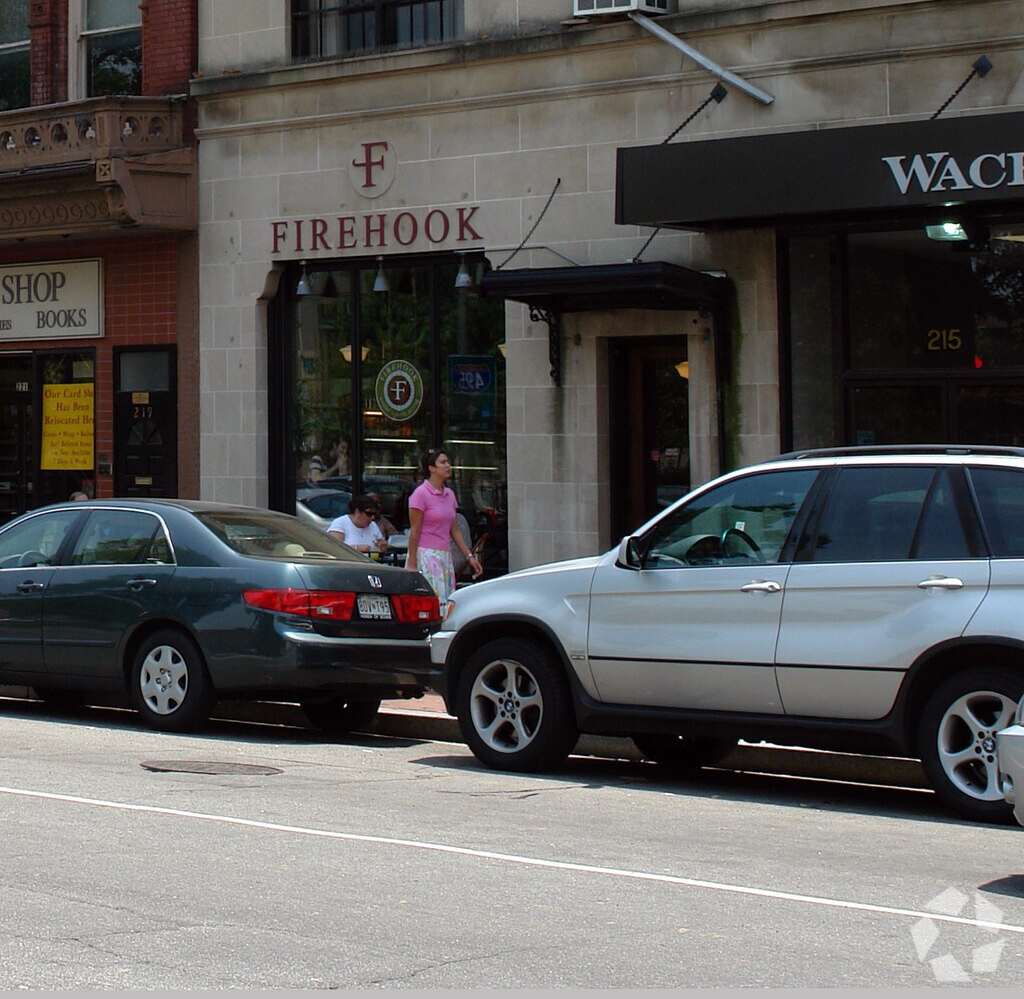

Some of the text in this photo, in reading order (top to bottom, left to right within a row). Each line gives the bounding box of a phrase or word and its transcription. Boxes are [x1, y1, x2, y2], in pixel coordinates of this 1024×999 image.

[270, 206, 484, 253] FIREHOOK
[2, 271, 66, 305] SHOP
[36, 308, 87, 329] BOOKS
[927, 329, 962, 350] 215
[44, 389, 60, 399] Our
[63, 388, 81, 398] Card
[56, 402, 90, 411] Has Been
[133, 406, 153, 419] 219
[45, 415, 80, 425] Relocated
